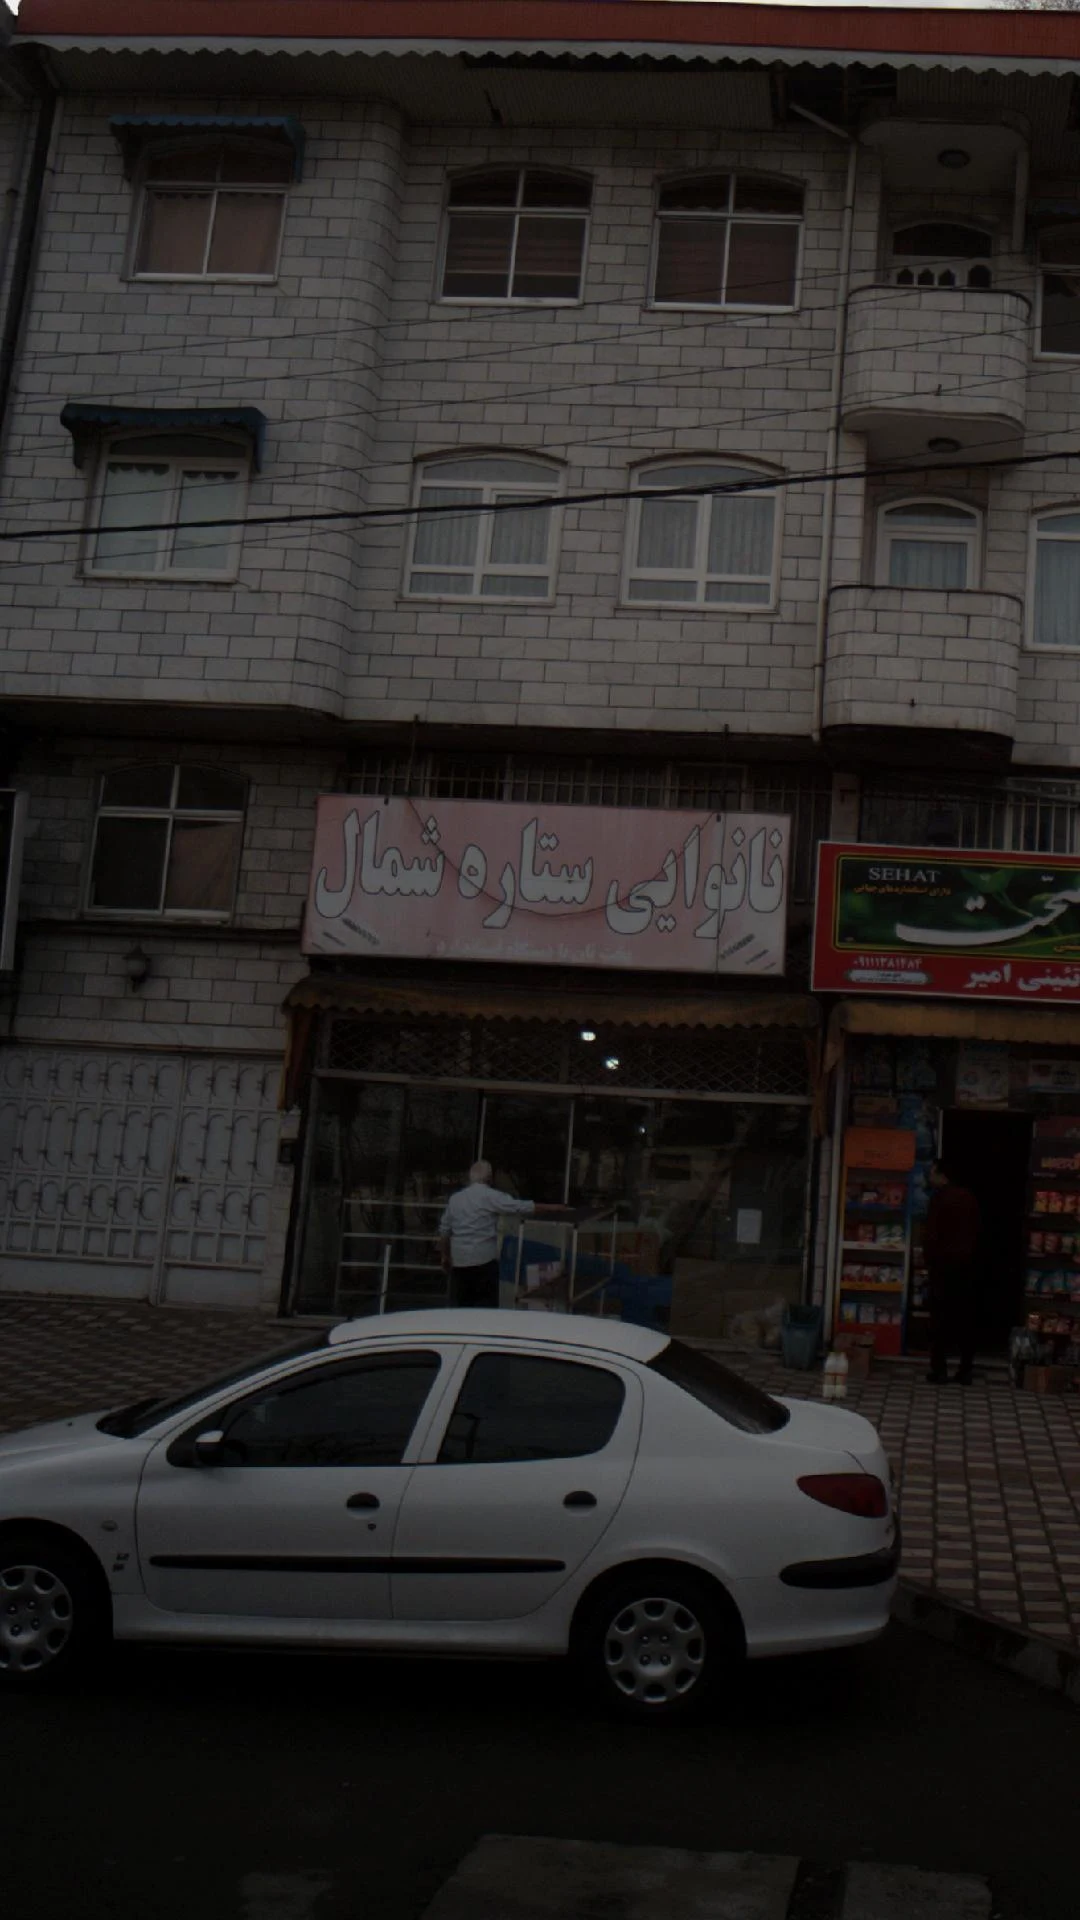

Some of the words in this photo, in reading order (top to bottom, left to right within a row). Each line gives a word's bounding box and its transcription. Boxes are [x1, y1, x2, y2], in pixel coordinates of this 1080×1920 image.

[314, 808, 445, 919] شمال
[457, 816, 595, 929] ستاره
[606, 825, 784, 940] نانوایی
[868, 866, 941, 884] SEHAT
[962, 962, 1012, 988] امیر
